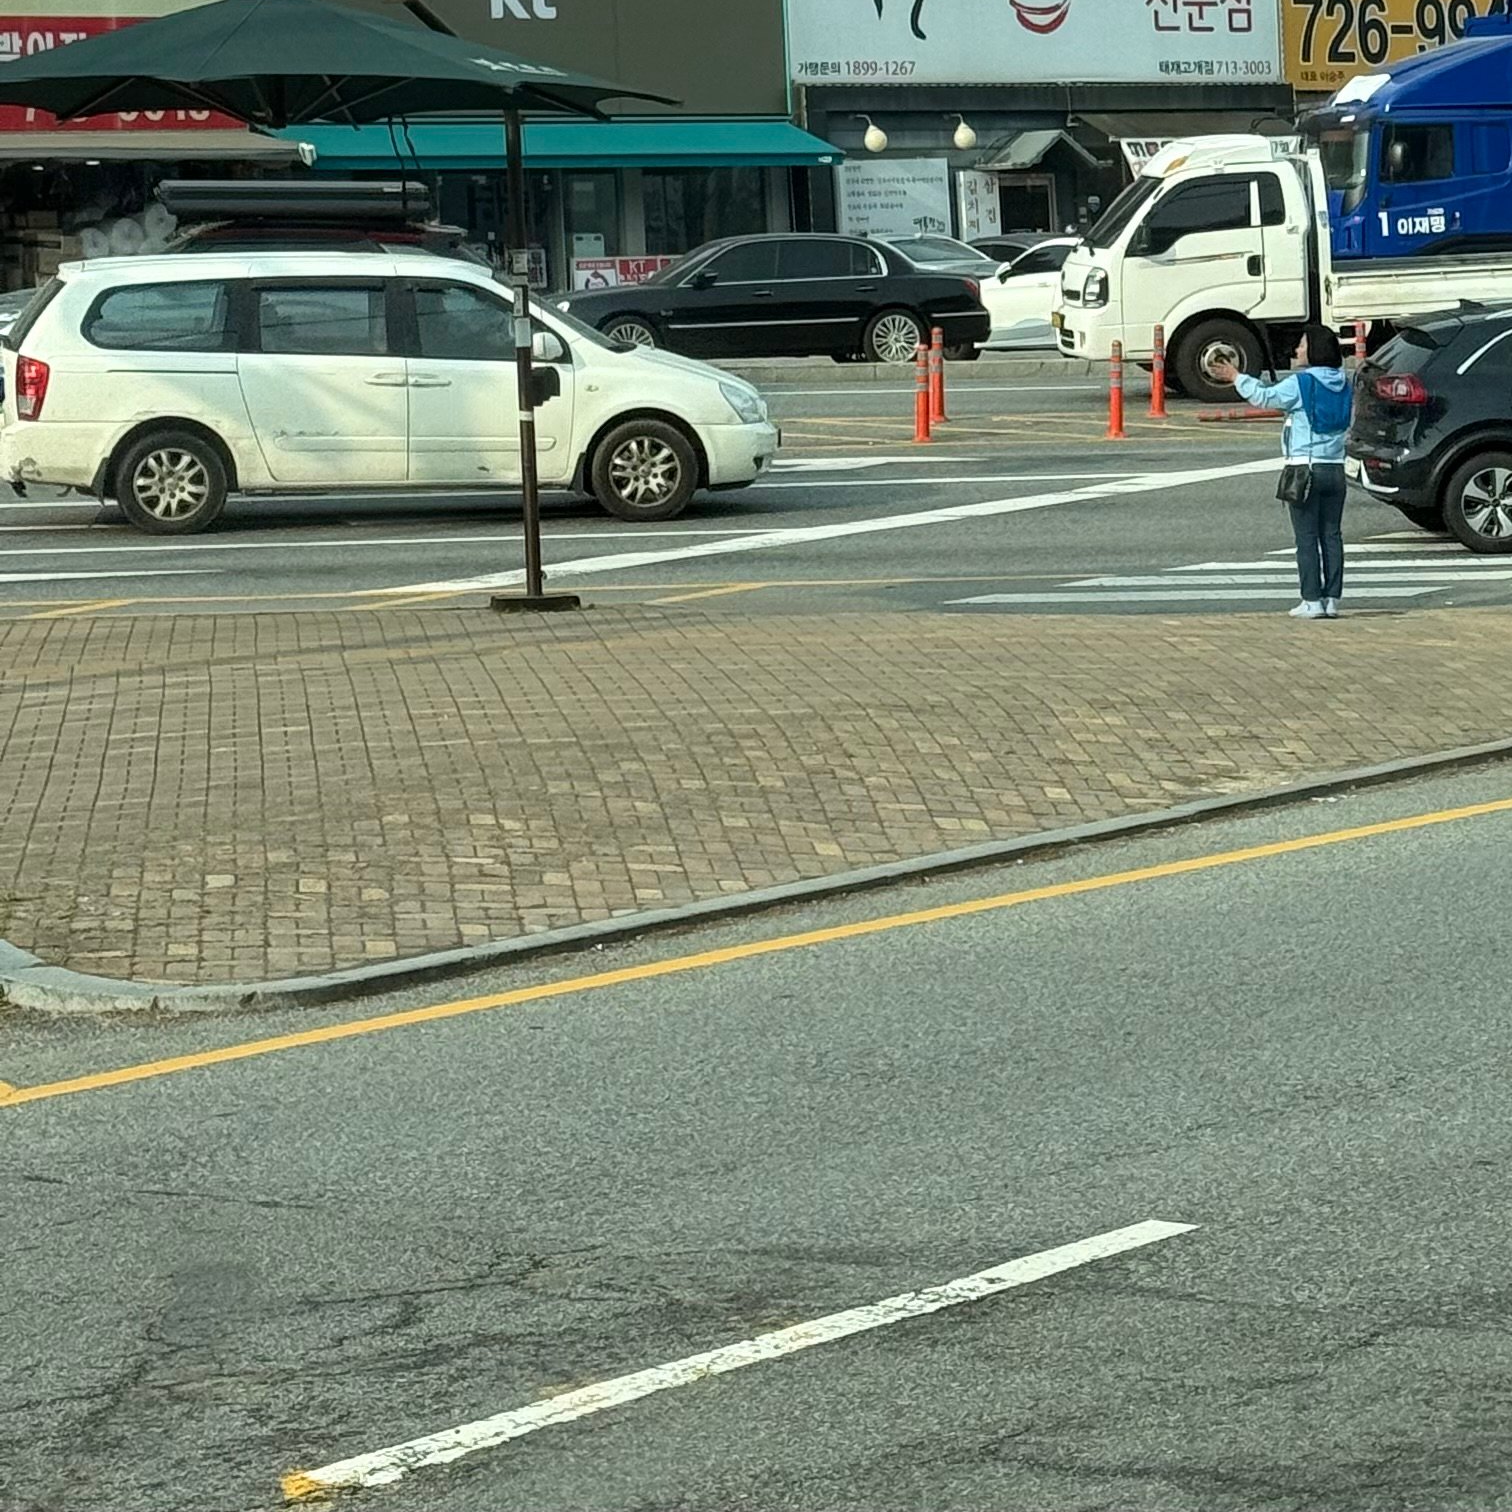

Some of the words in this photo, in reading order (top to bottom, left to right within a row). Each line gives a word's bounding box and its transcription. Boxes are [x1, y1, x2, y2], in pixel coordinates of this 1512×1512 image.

[844, 60, 916, 76] 1899-1267
[1216, 60, 1272, 76] 713-3003
[1378, 211, 1389, 237] 1
